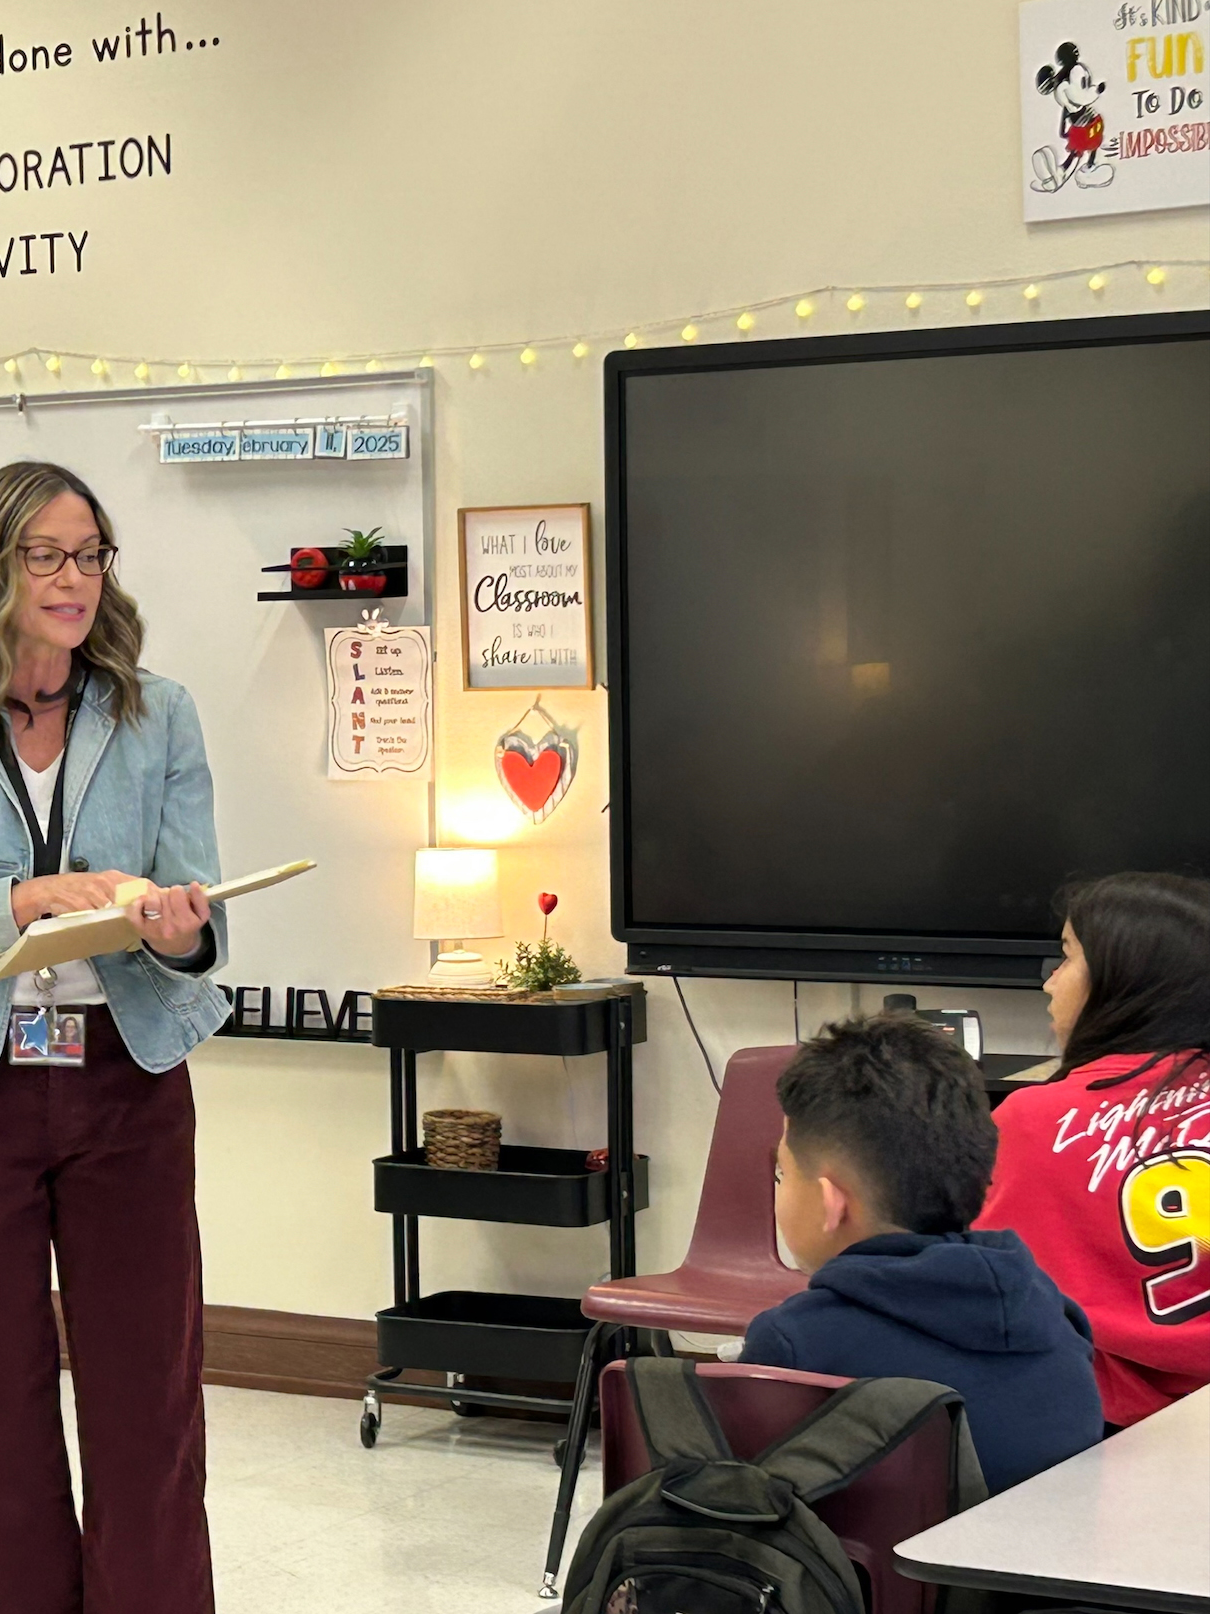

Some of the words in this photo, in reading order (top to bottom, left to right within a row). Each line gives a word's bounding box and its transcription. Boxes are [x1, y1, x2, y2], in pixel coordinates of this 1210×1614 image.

[92, 12, 220, 63] with...
[1131, 89, 1161, 119] TO
[1168, 86, 1204, 116] DO
[353, 433, 400, 454] 2025
[481, 535, 516, 555] WHAT
[523, 535, 527, 555] I
[535, 519, 572, 555] love
[474, 572, 583, 613] Classroom
[481, 635, 532, 668] share
